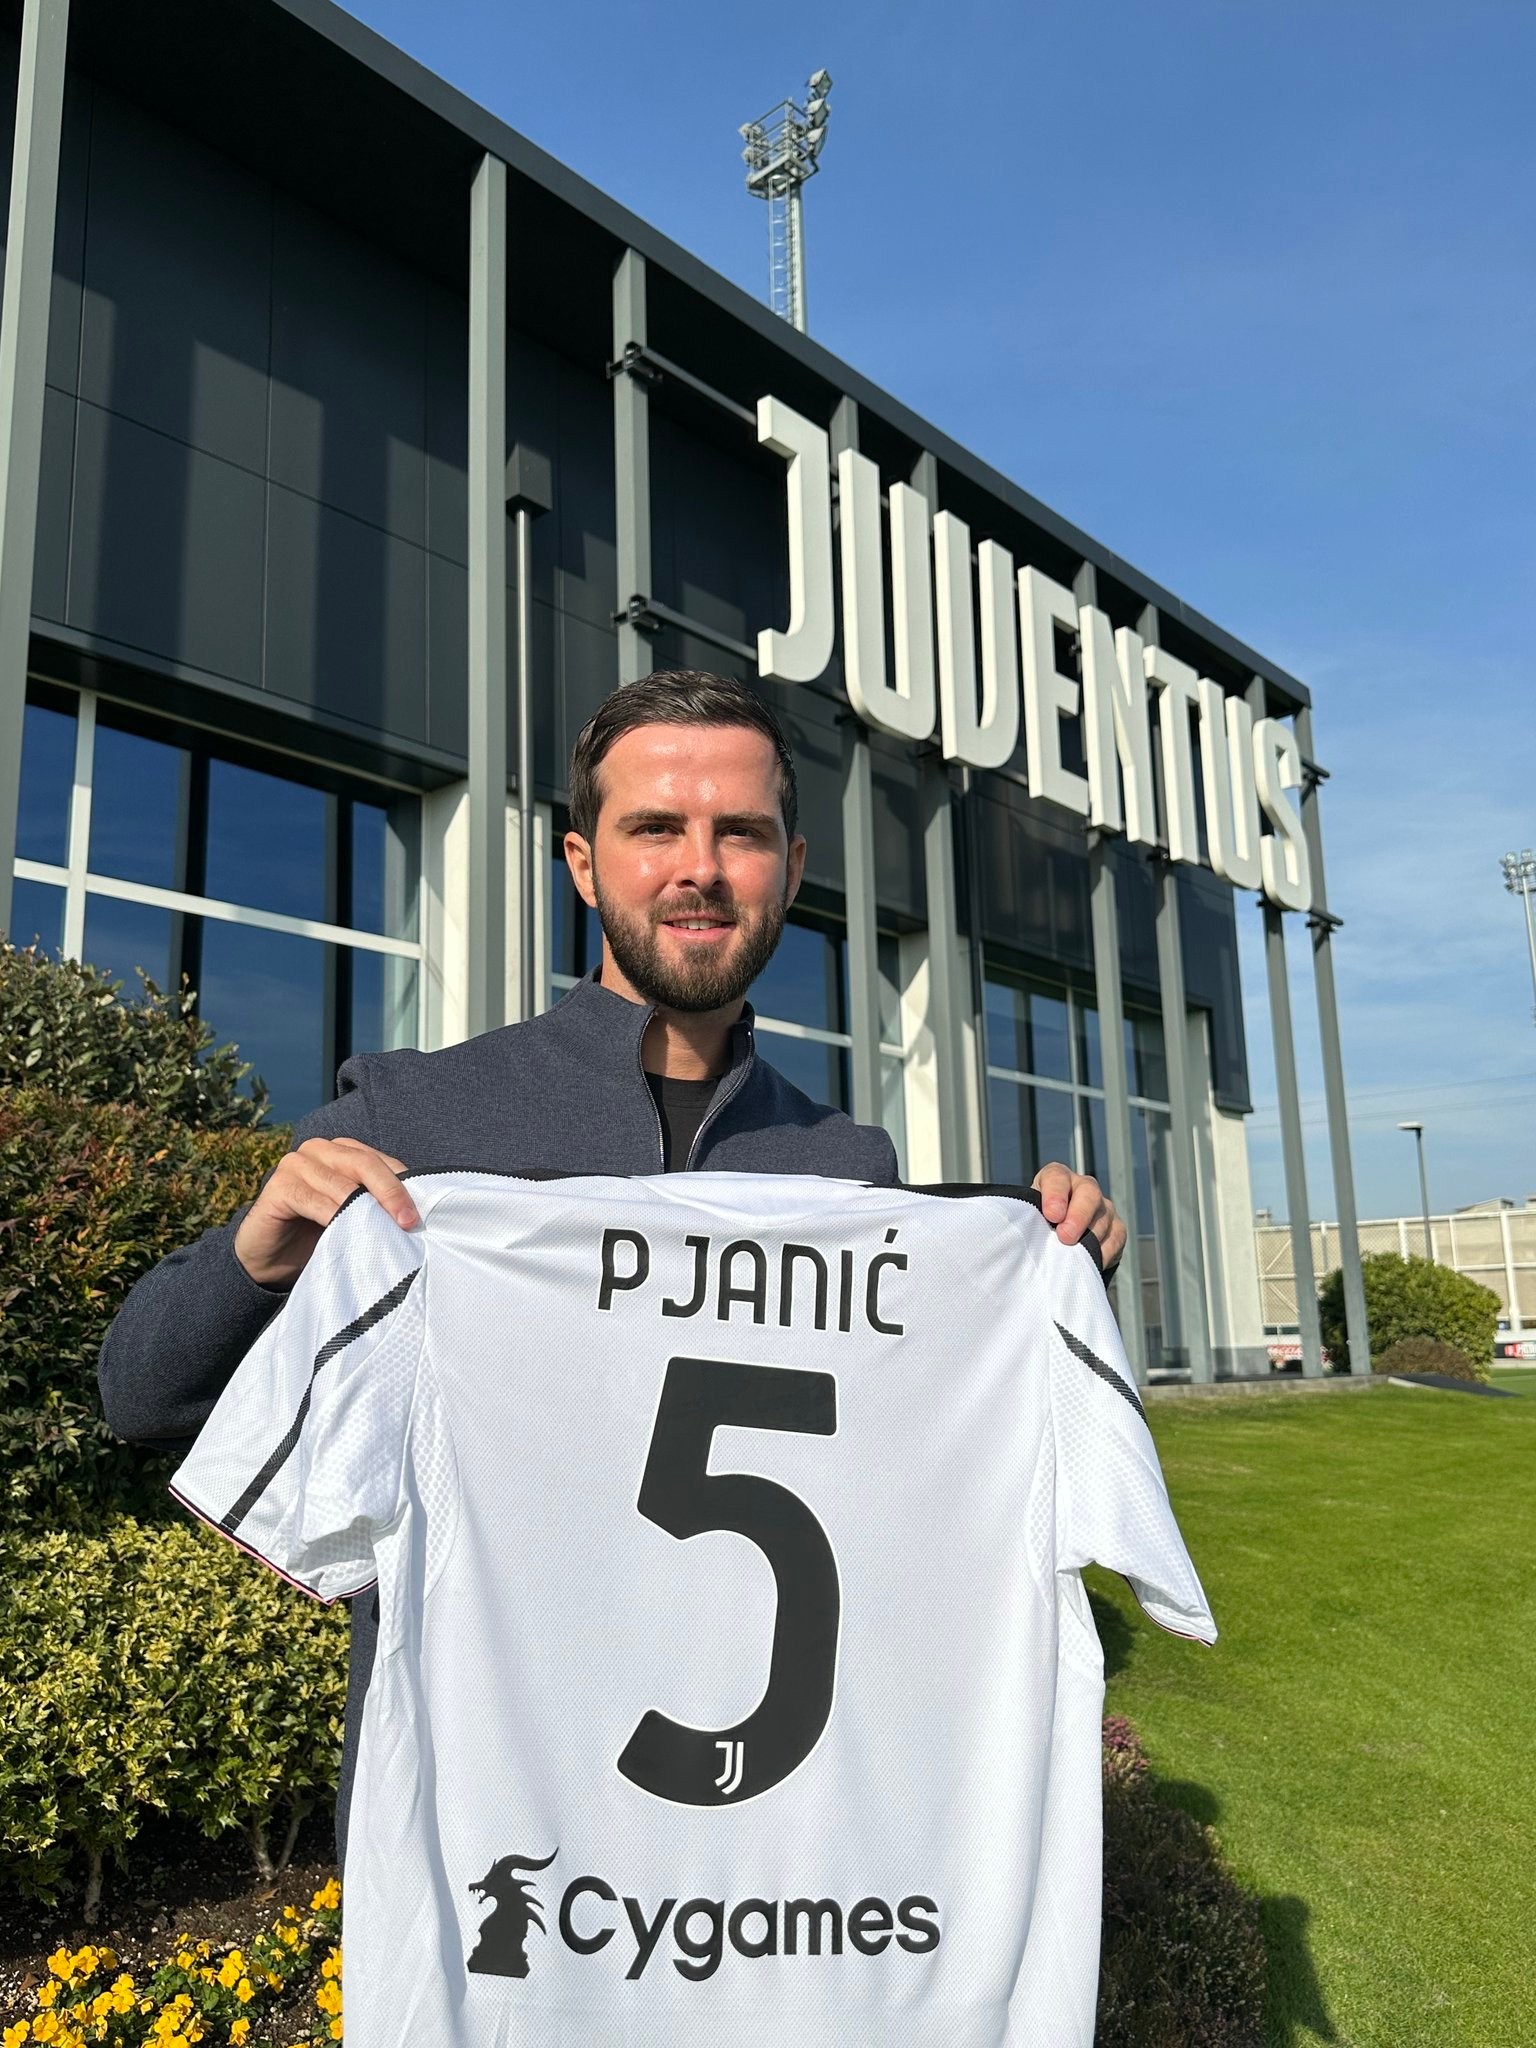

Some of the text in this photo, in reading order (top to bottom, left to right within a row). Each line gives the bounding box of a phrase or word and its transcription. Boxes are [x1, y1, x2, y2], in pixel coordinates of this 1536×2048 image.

[757, 394, 1312, 912] JUVENTUS
[598, 1228, 908, 1336] PJANIĆ
[617, 1356, 840, 1807] 5
[558, 1875, 941, 1982] Cygames
